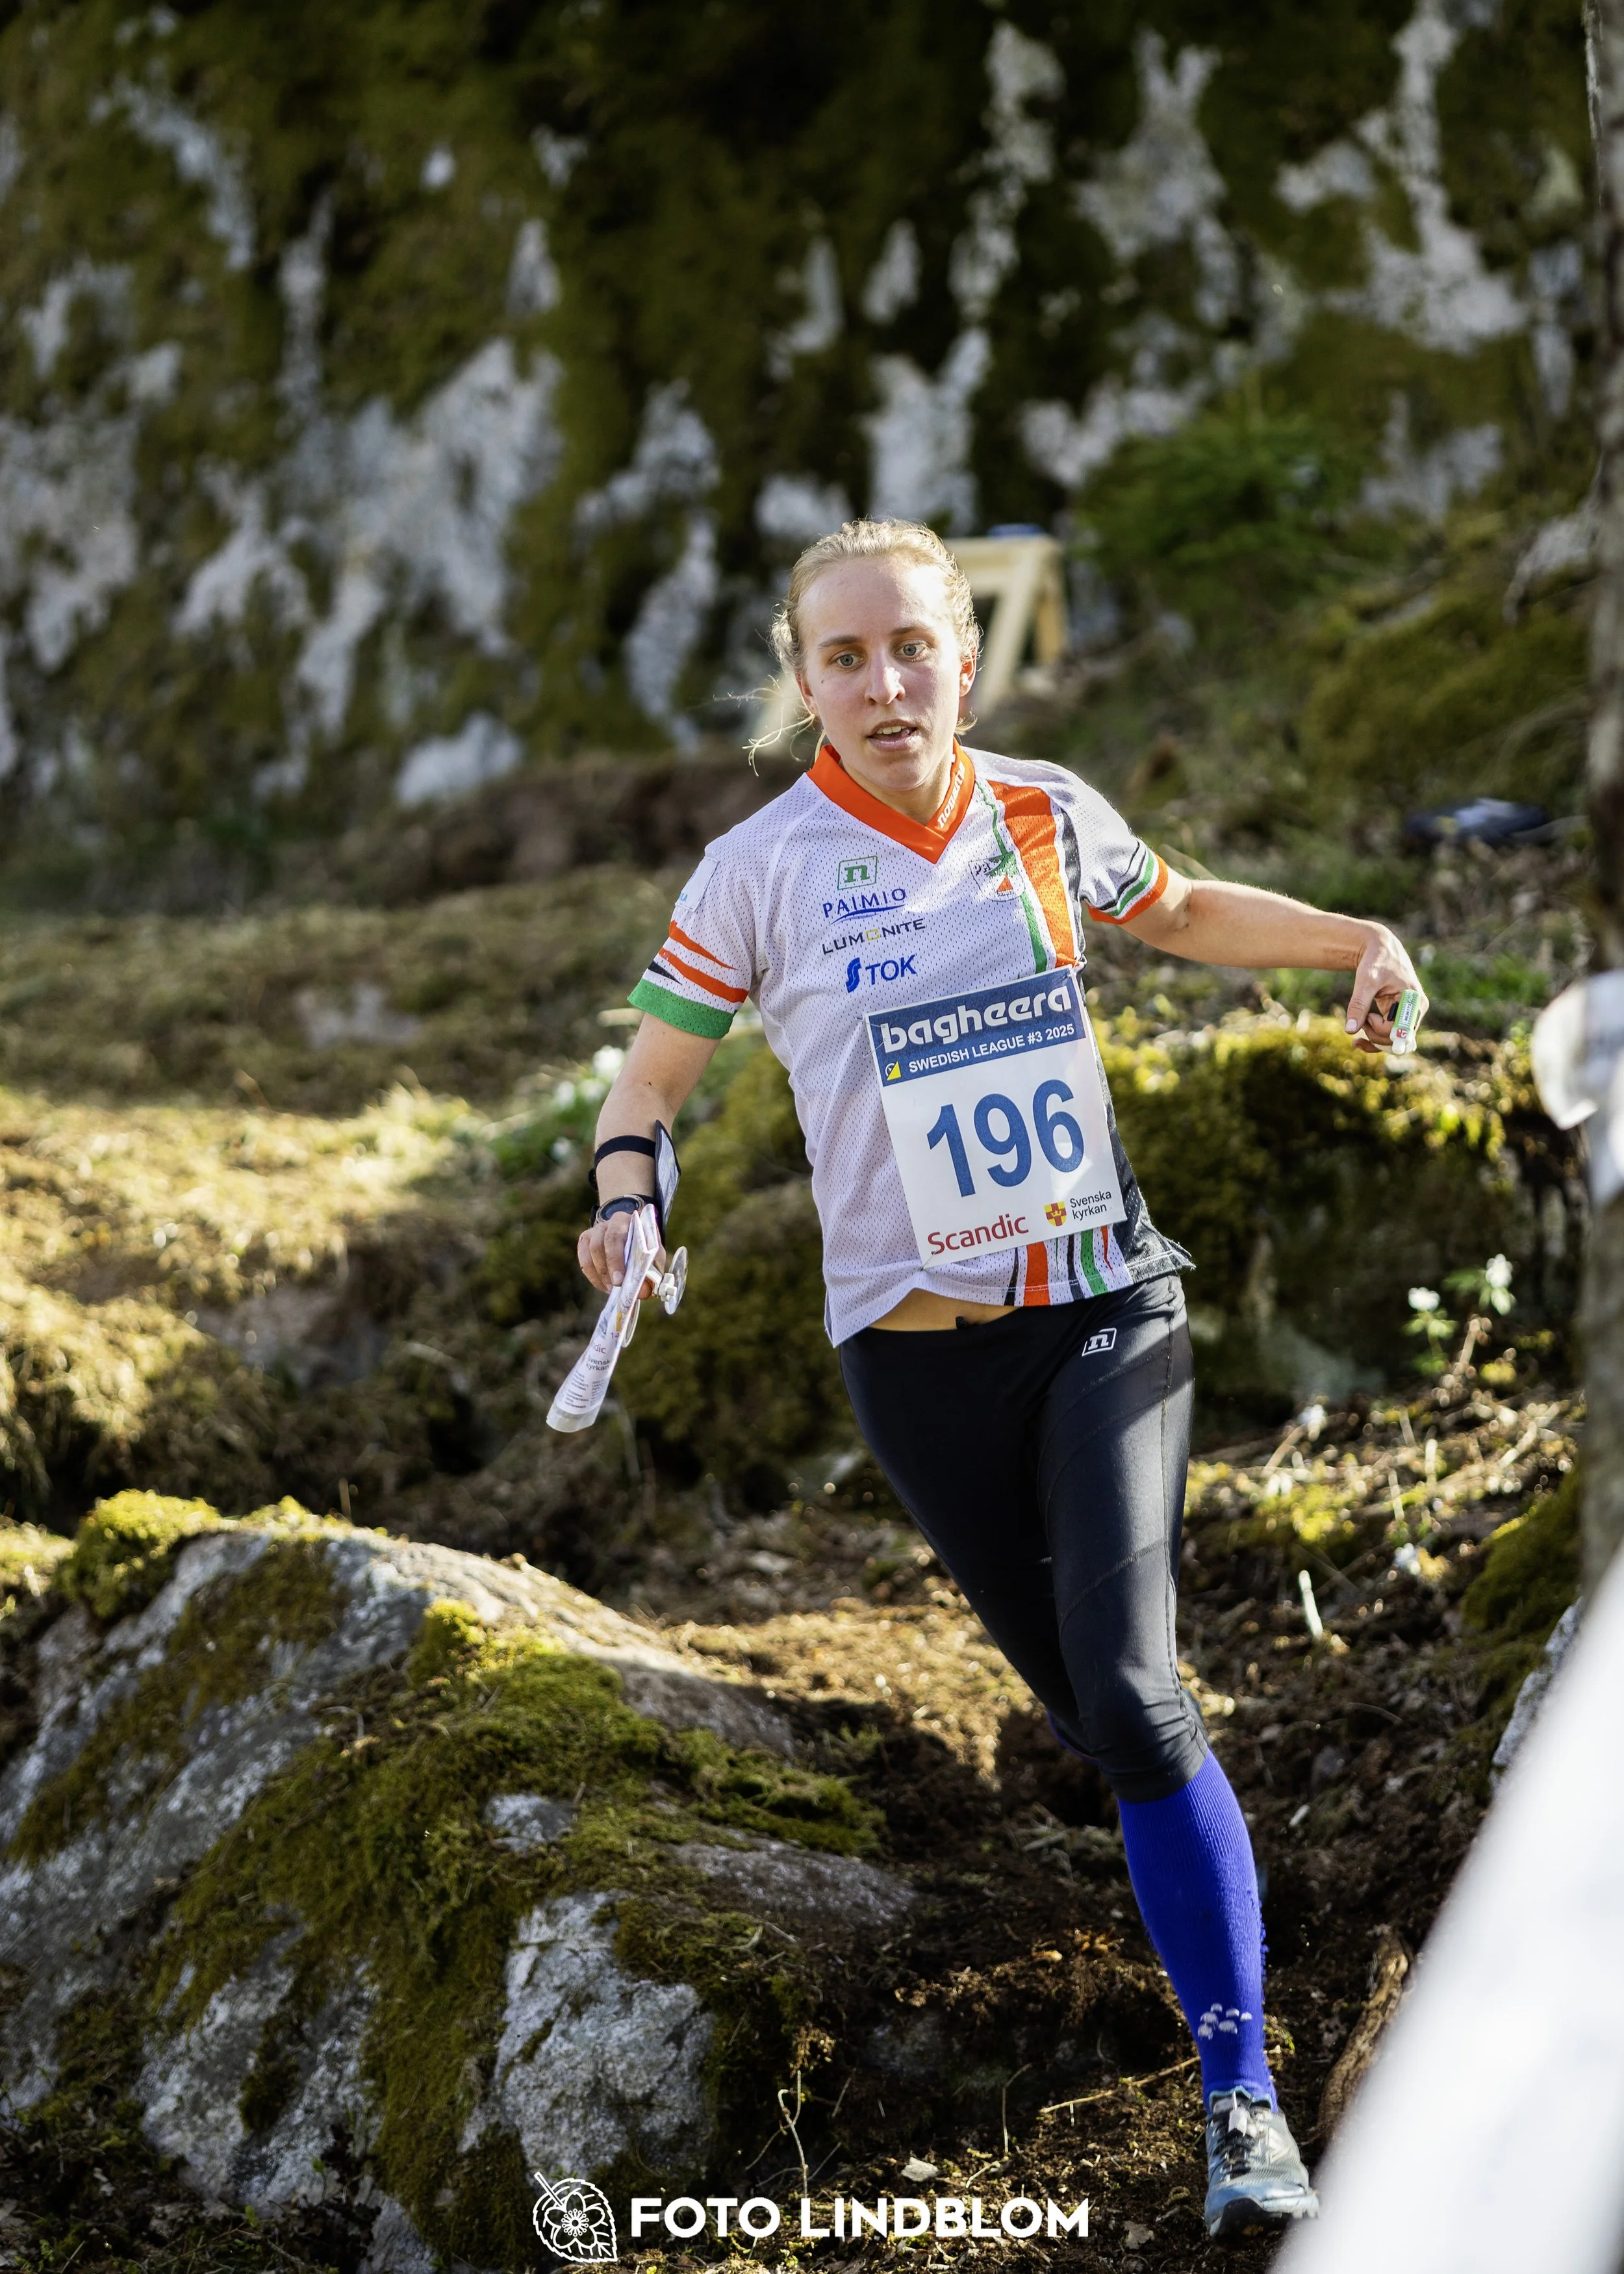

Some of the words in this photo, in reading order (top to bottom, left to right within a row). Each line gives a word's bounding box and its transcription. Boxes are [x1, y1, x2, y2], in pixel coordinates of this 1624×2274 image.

[822, 888, 906, 918] PAIMIO
[822, 918, 926, 956] LUMONITE
[880, 985, 1072, 1053] bagheera
[908, 1048, 970, 1073] SWEDISH
[972, 1034, 1026, 1058] LEAGUE
[1027, 1030, 1043, 1045] #3
[1045, 1023, 1075, 1041] 2025
[926, 1079, 1084, 1197] 196
[1069, 1190, 1112, 1208] Svenska
[1072, 1202, 1108, 1221] kyrkan
[927, 1213, 1029, 1255] Scandic
